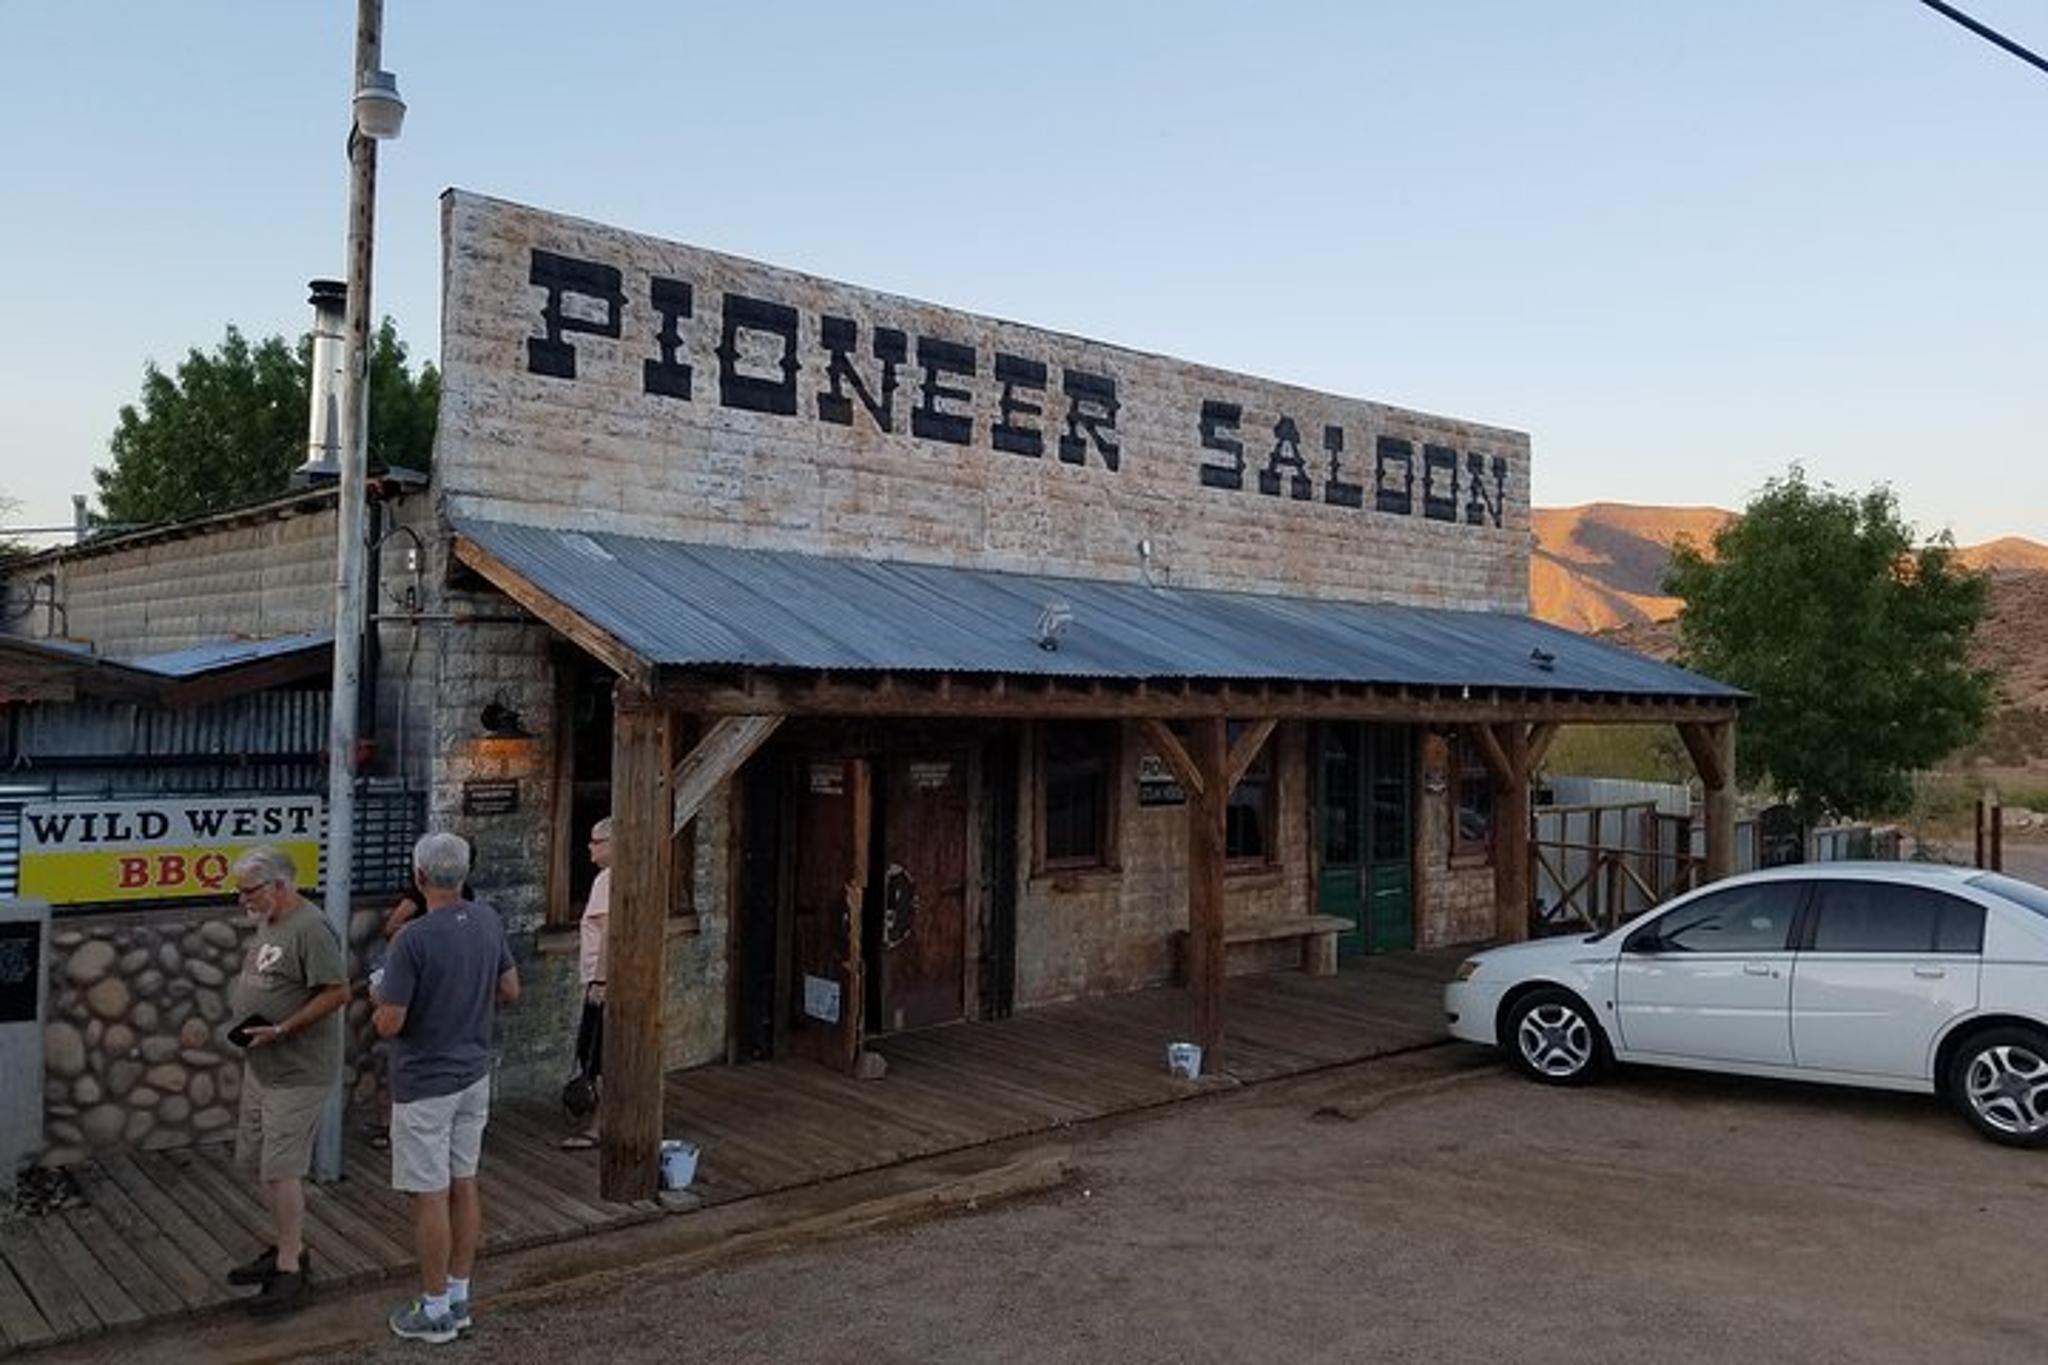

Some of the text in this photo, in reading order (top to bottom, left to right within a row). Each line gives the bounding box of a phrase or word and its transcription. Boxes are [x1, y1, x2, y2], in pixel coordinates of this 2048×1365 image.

[526, 248, 1507, 528] PIONEER SALOON
[28, 806, 314, 843] WILD WEST
[118, 854, 229, 888] BBQ
